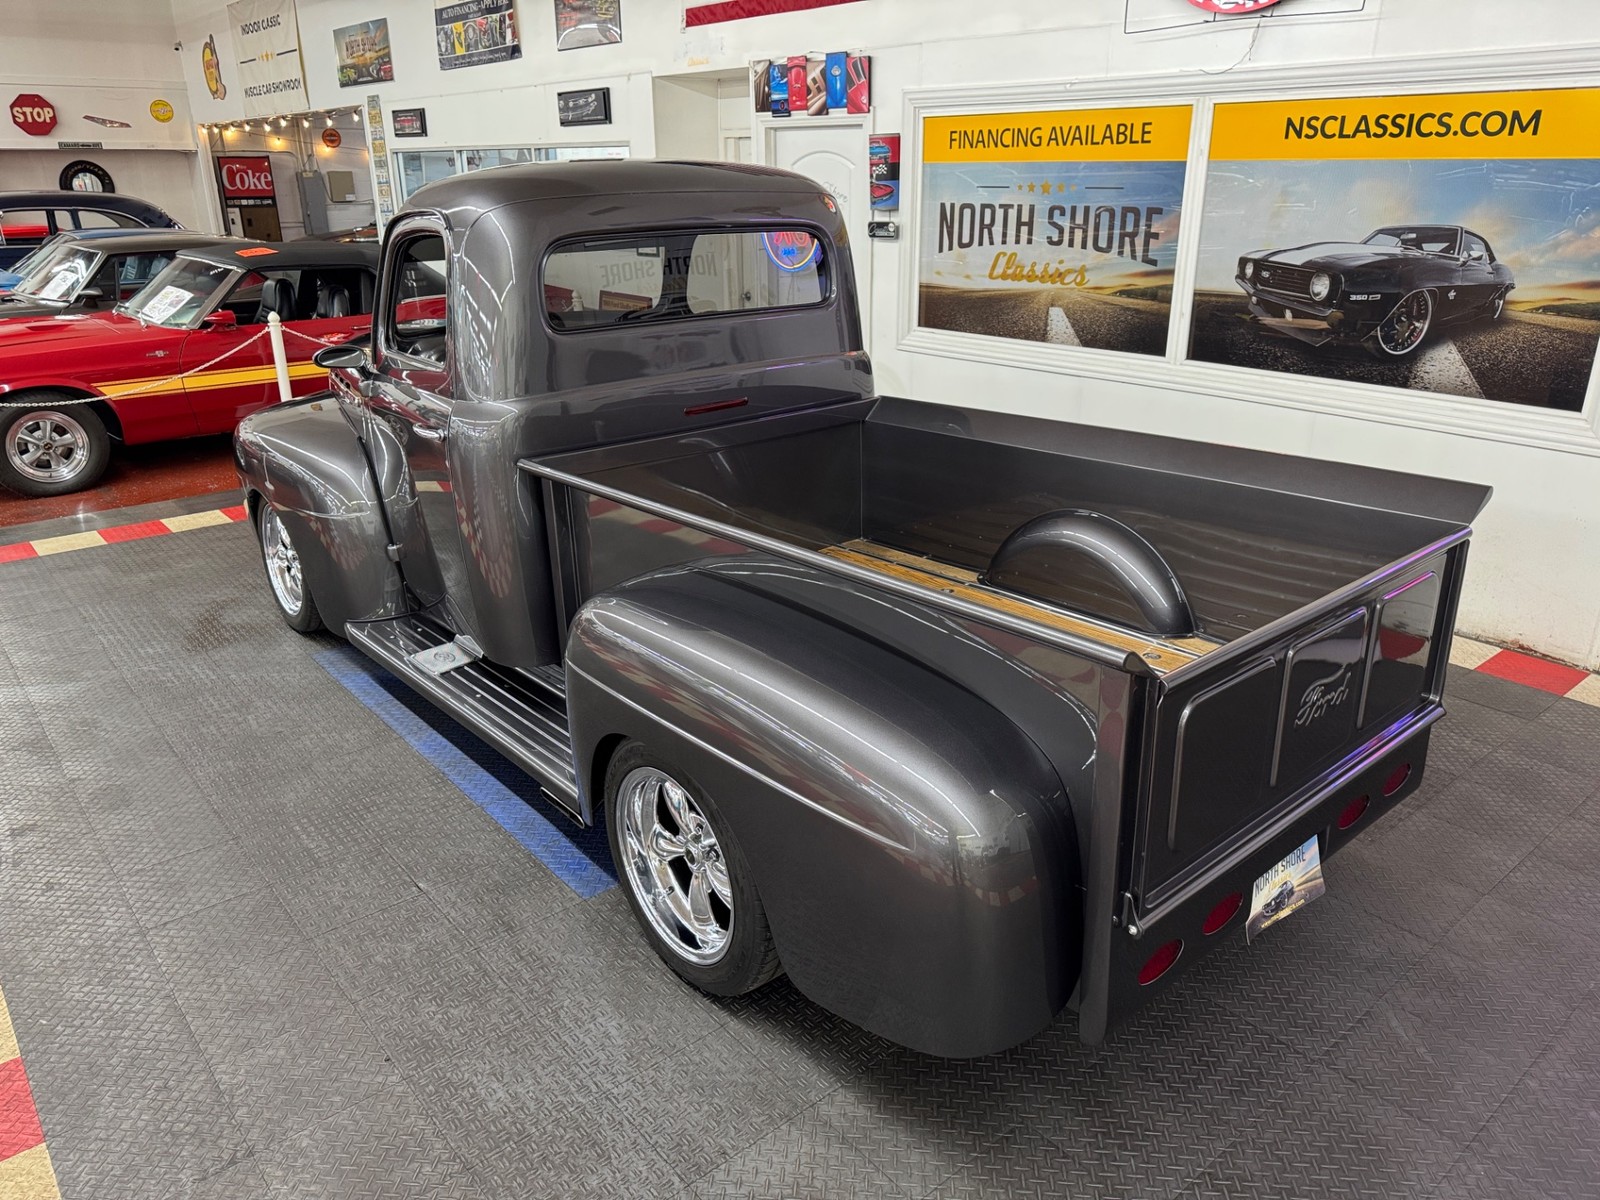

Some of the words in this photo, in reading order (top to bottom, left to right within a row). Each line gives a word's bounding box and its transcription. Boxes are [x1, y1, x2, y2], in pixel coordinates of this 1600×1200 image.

[241, 20, 261, 36] INDOOR
[261, 14, 281, 31] CLASSIC
[262, 83, 273, 95] CAR
[12, 107, 54, 123] STOP
[1284, 109, 1542, 140] NSCLASSICS.COM
[949, 126, 1043, 149] FINANCING
[1047, 122, 1152, 147] AVAILABLE
[221, 164, 273, 190] Coke
[938, 202, 1035, 253] NORTH
[1046, 204, 1163, 267] SHORE
[988, 251, 1089, 287] Classics
[1294, 664, 1352, 728] Ford
[1254, 863, 1279, 898] NORTH
[1281, 845, 1307, 873] SHORE
